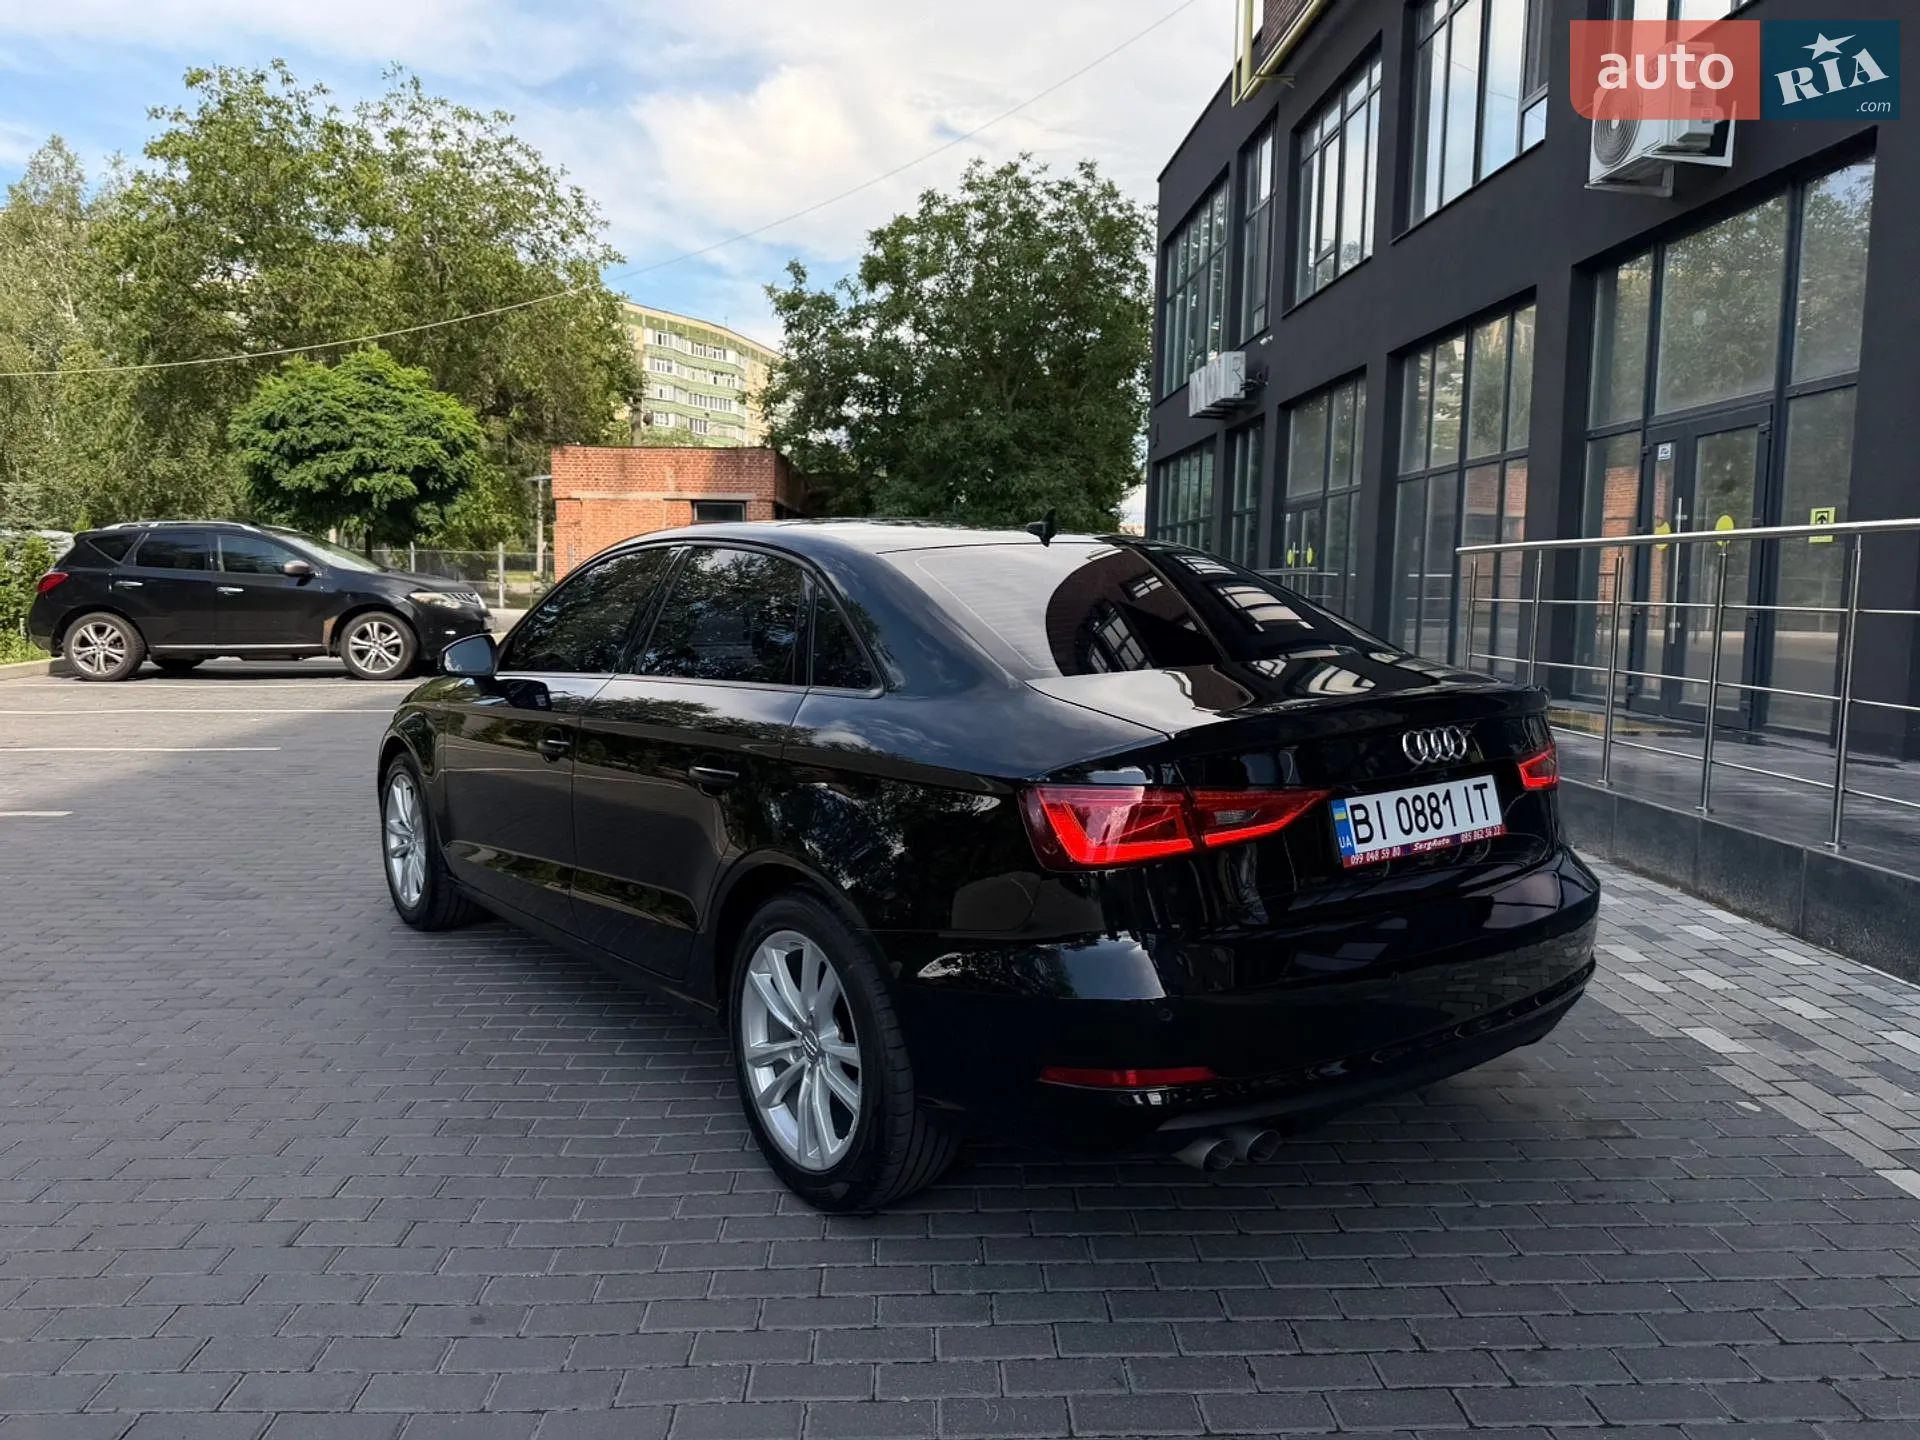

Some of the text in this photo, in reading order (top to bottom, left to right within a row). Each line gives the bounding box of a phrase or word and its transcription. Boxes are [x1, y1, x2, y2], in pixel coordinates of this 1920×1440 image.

[1350, 783, 1489, 844] BI 0881 IT
[1338, 836, 1353, 848] UA
